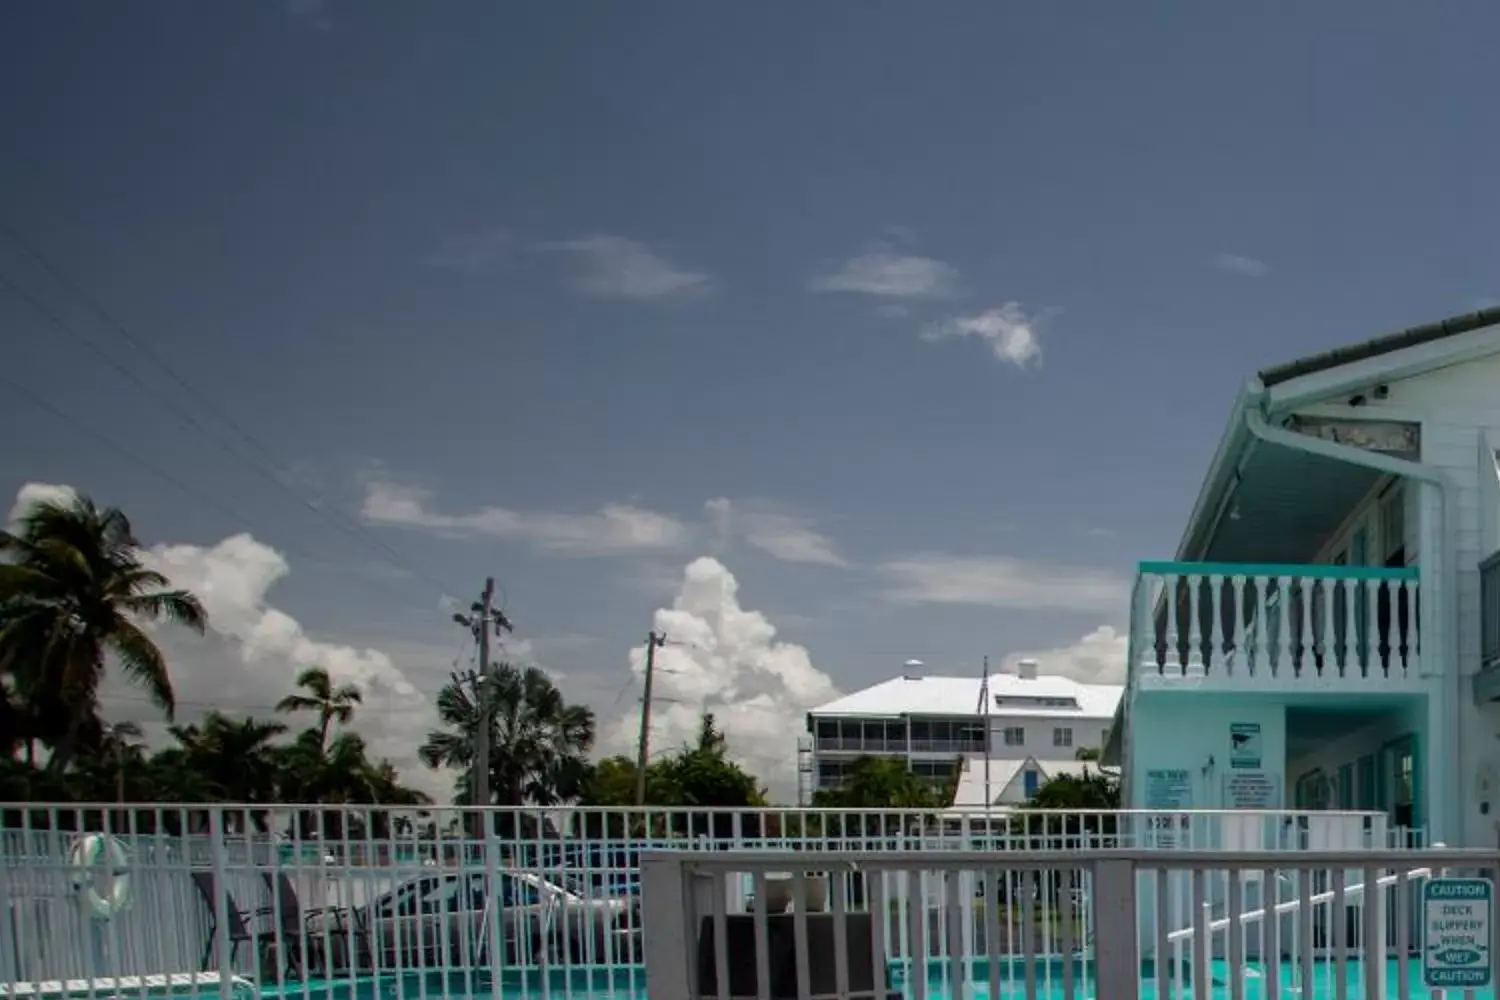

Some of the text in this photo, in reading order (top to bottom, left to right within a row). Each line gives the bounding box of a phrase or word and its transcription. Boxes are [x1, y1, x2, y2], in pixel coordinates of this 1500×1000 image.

[1430, 884, 1485, 896] CAUTION
[1441, 905, 1473, 915] DECK
[1432, 920, 1483, 931] SLIPPERY
[1440, 935, 1475, 945] WHEN
[1445, 950, 1471, 962] WET
[1430, 970, 1485, 981] CAUTION
